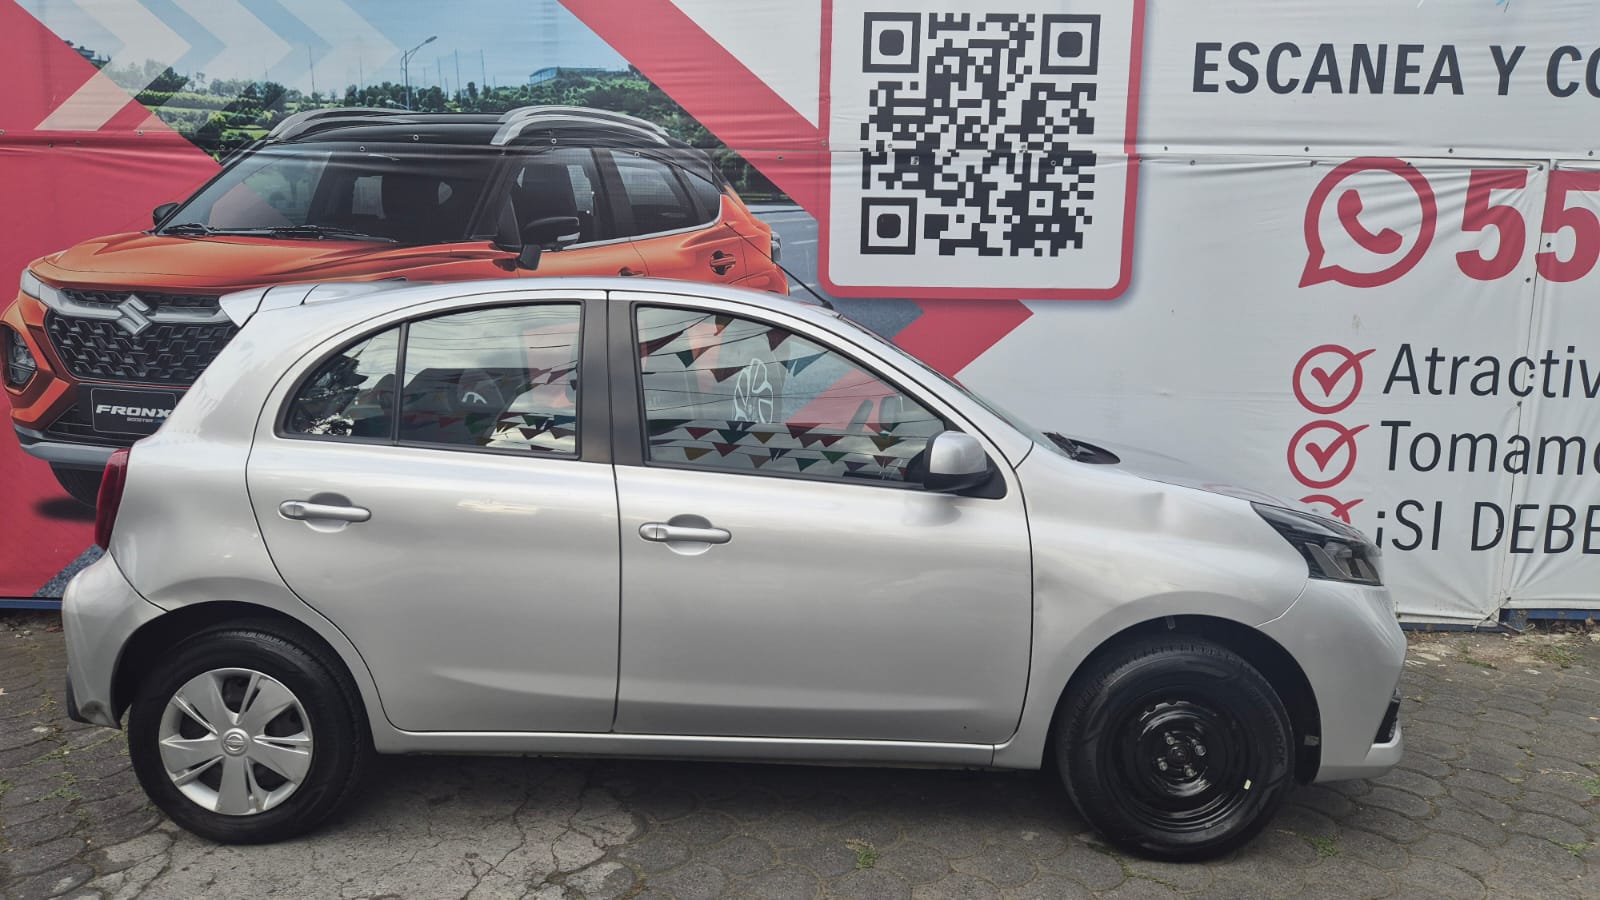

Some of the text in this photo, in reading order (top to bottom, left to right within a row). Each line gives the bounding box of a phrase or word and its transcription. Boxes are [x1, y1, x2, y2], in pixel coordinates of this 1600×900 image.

[1192, 41, 1464, 96] ESCANEA
[1489, 45, 1526, 96] Y
[1456, 168, 1600, 283] 55
[1383, 343, 1600, 398] Atractiv
[96, 404, 173, 417] FRONX
[1380, 420, 1600, 475] Tomam
[1470, 501, 1600, 554] DEBE
